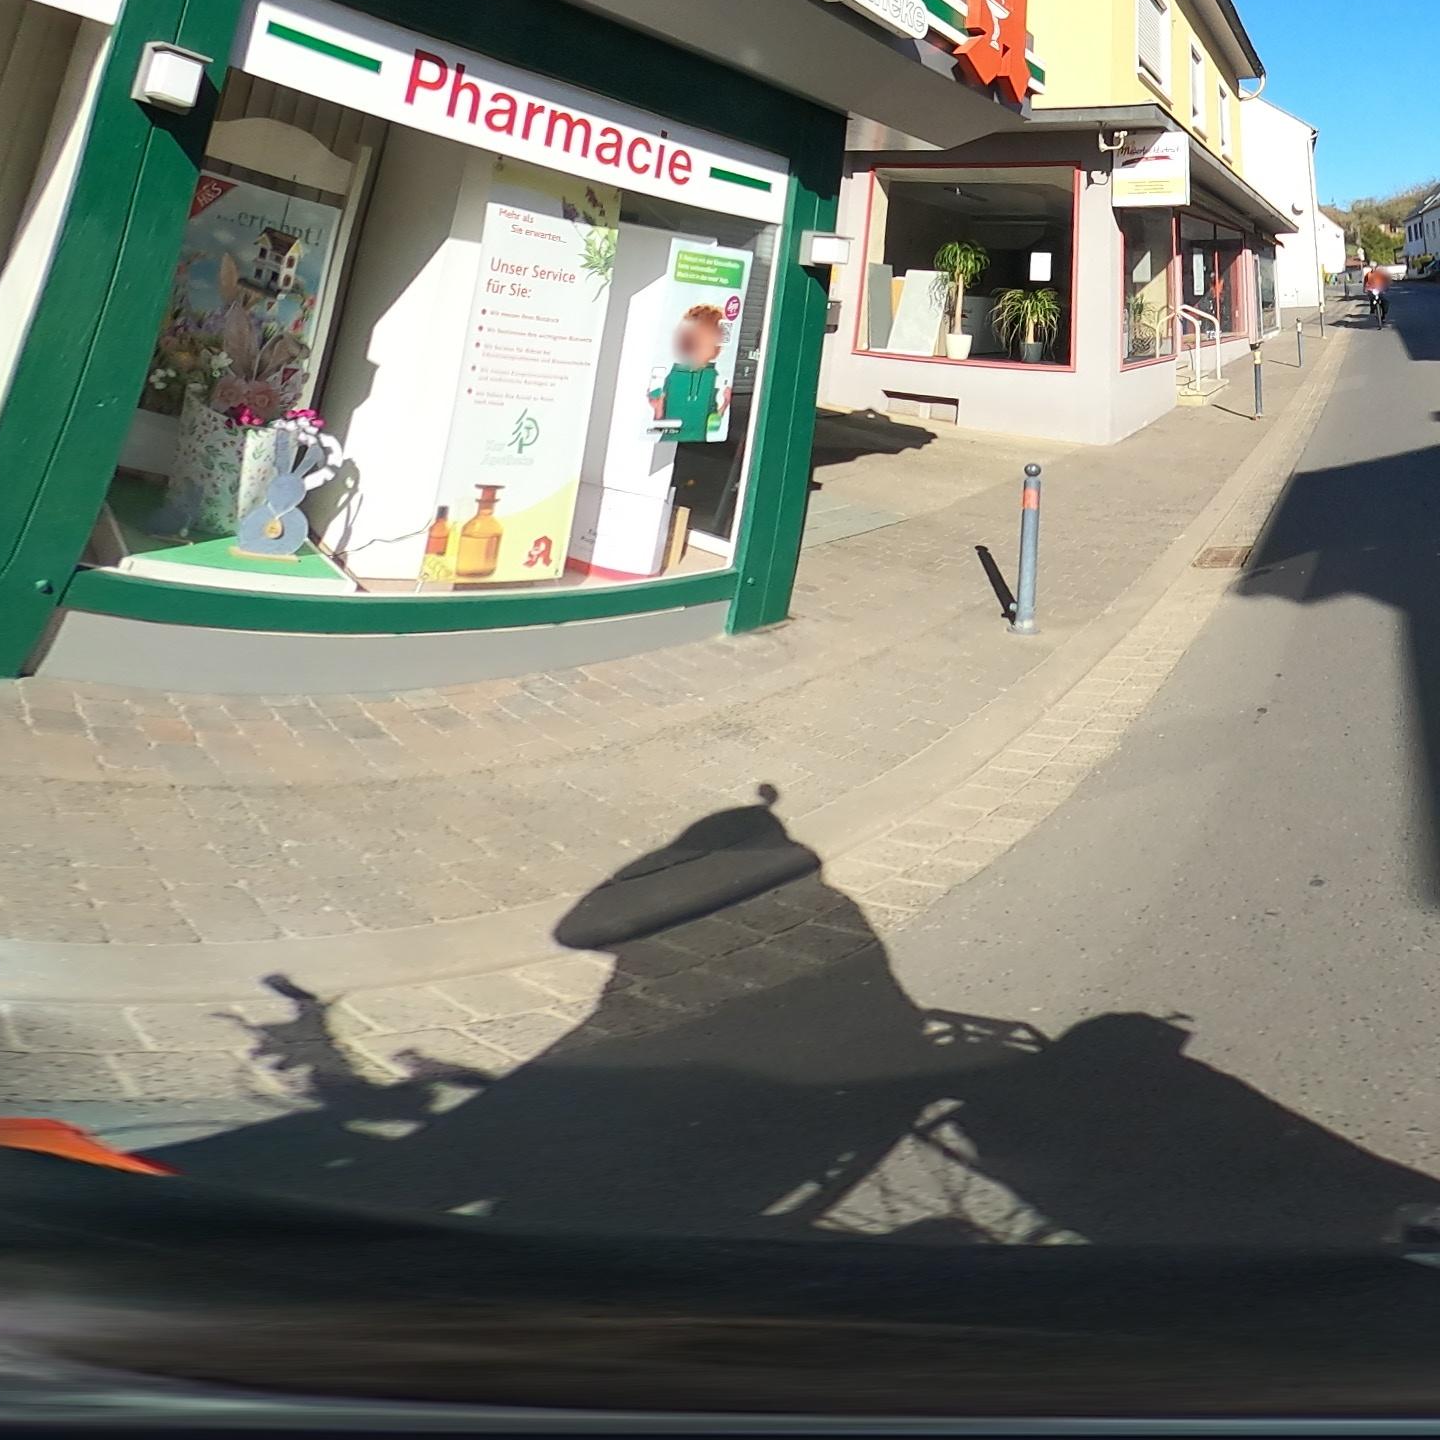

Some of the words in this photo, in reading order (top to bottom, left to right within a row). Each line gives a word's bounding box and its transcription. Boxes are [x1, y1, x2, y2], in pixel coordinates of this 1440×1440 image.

[404, 47, 693, 186] Pharmacie
[499, 207, 520, 221] Mehr
[522, 212, 534, 224] als
[511, 224, 524, 236] Sie
[490, 256, 529, 277] Unser
[532, 264, 577, 284] Service
[485, 278, 506, 296] für
[509, 282, 532, 299] Sie:
